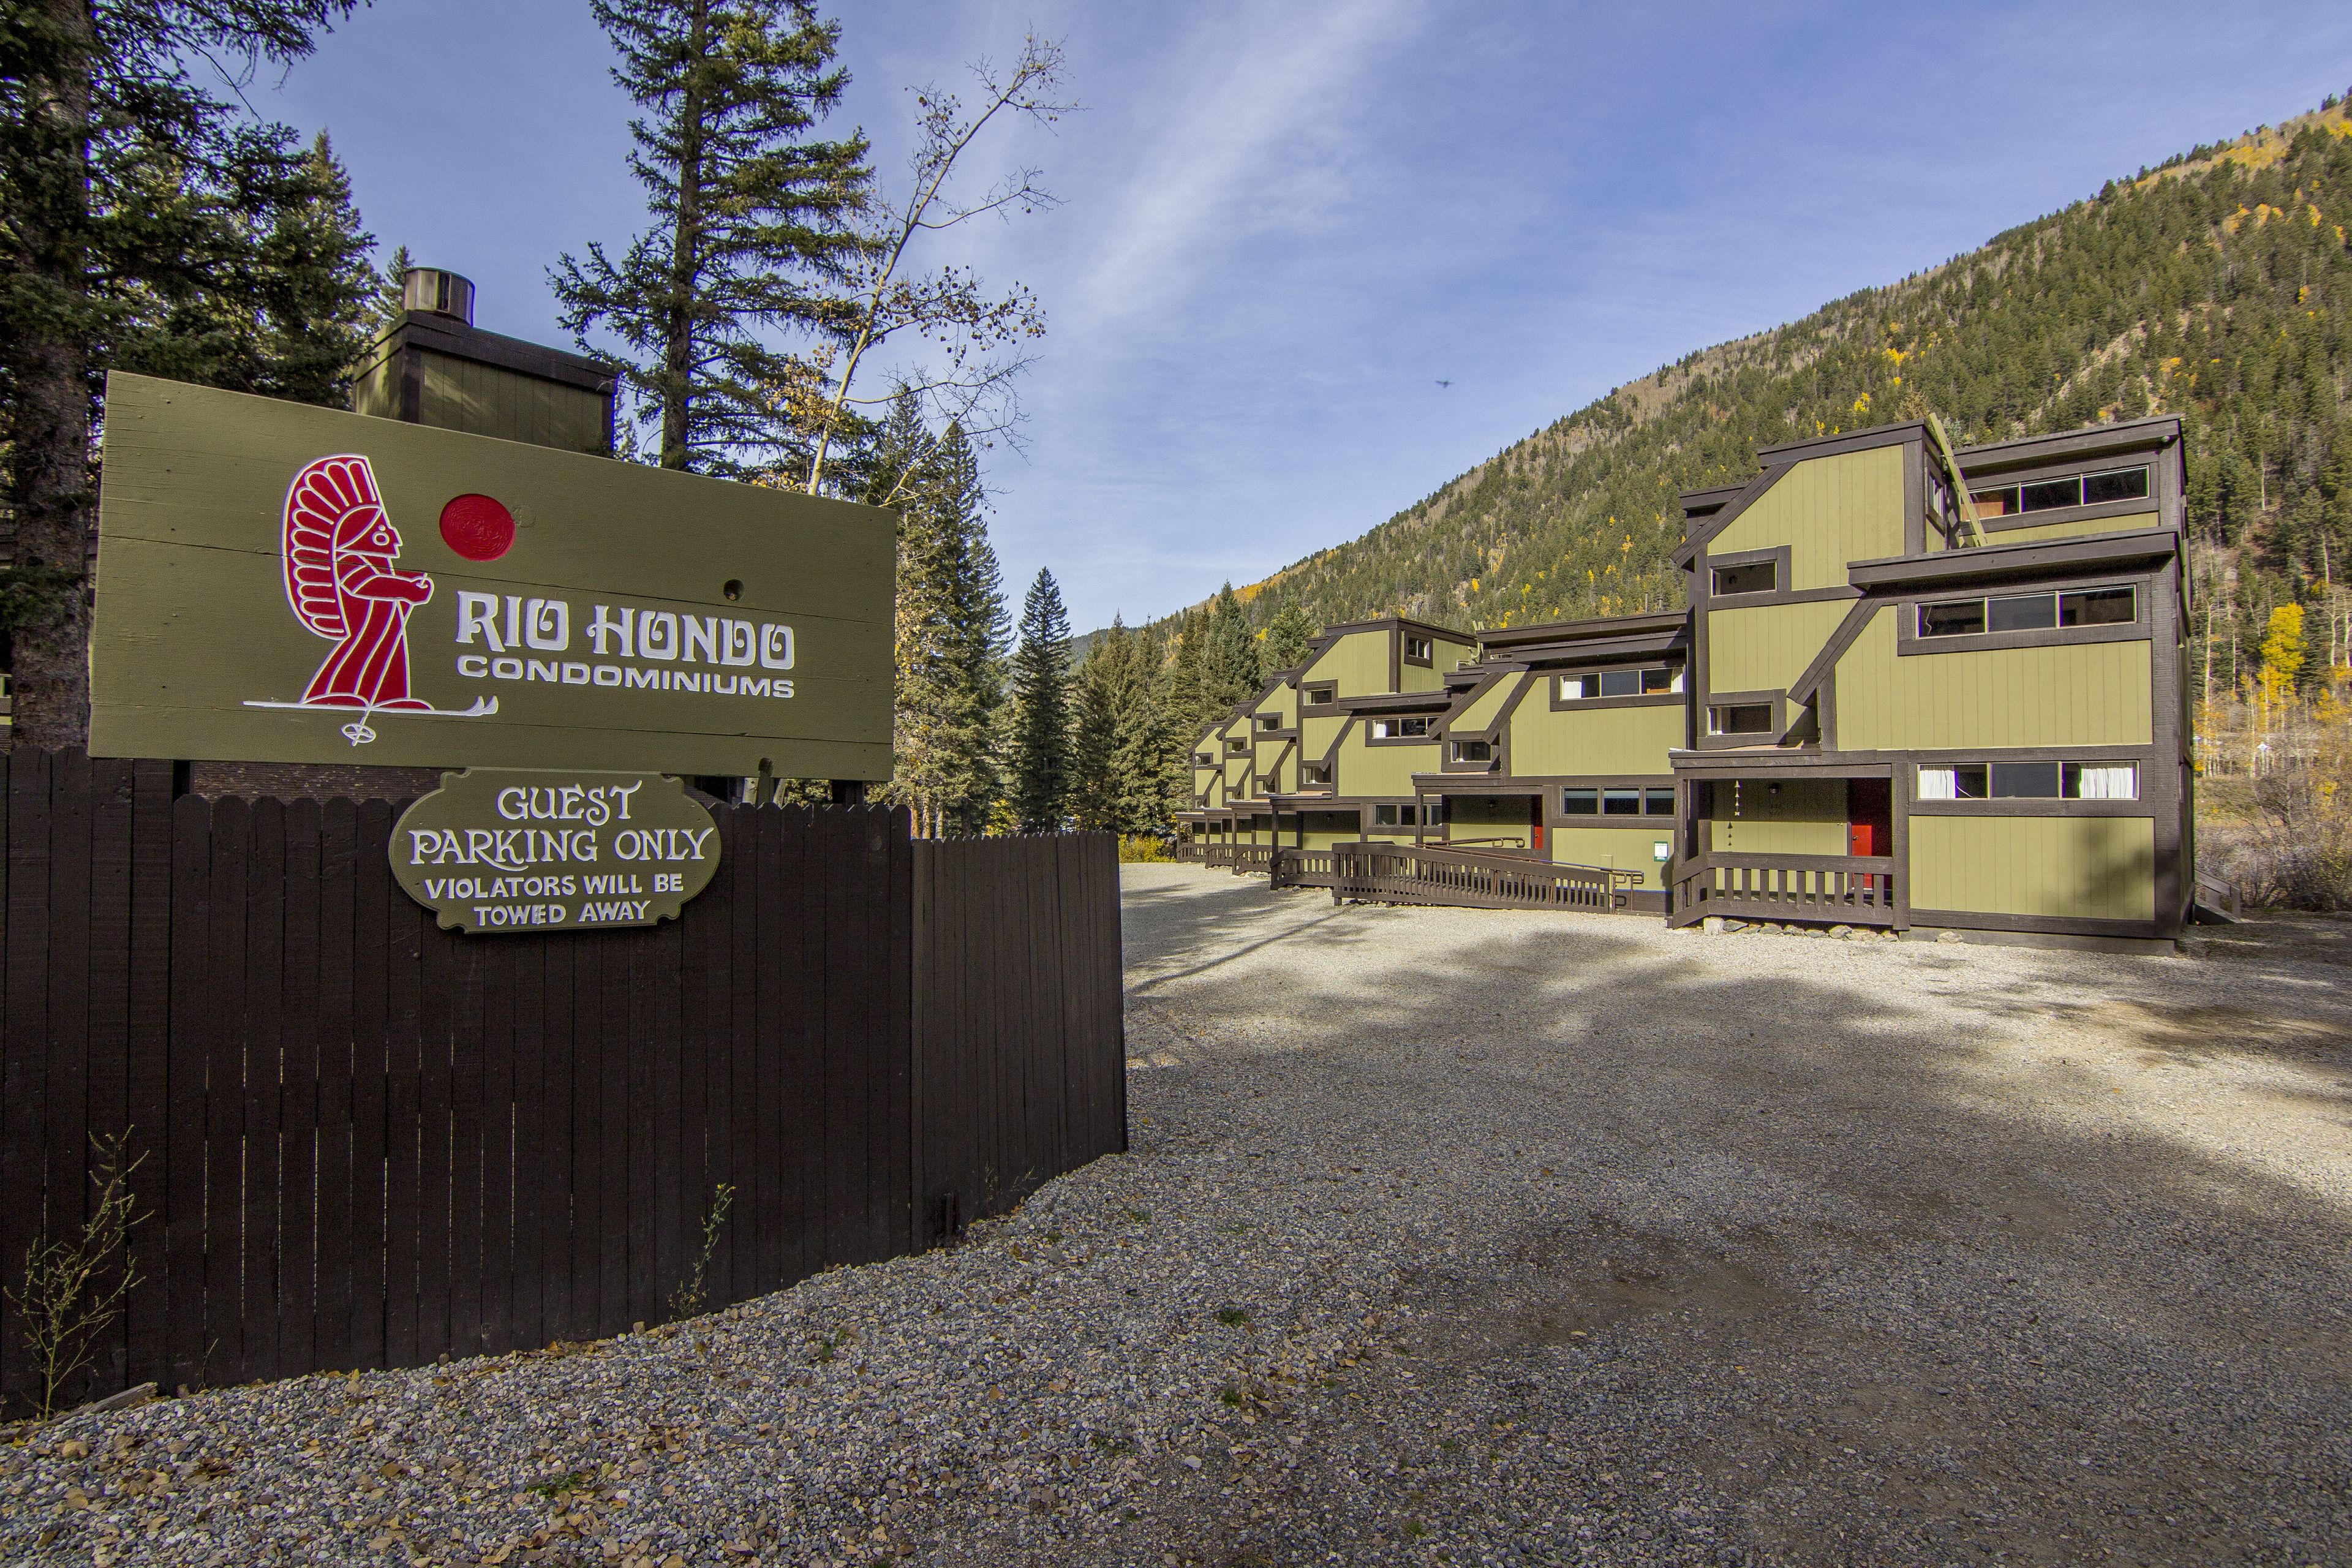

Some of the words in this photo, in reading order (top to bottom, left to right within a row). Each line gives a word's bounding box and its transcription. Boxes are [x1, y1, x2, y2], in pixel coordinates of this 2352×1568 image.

[456, 590, 569, 651] RIO
[586, 605, 794, 669] HONDO
[457, 655, 794, 698] CONDOMINIUMS
[498, 780, 643, 826] GUEST
[409, 828, 598, 872] PARKING
[614, 827, 714, 860] ONLY
[424, 875, 576, 899] VIOLATORS
[583, 874, 642, 894] WILL
[654, 873, 683, 892] BE
[473, 904, 566, 926] TOWED
[579, 900, 652, 921] AWAY
